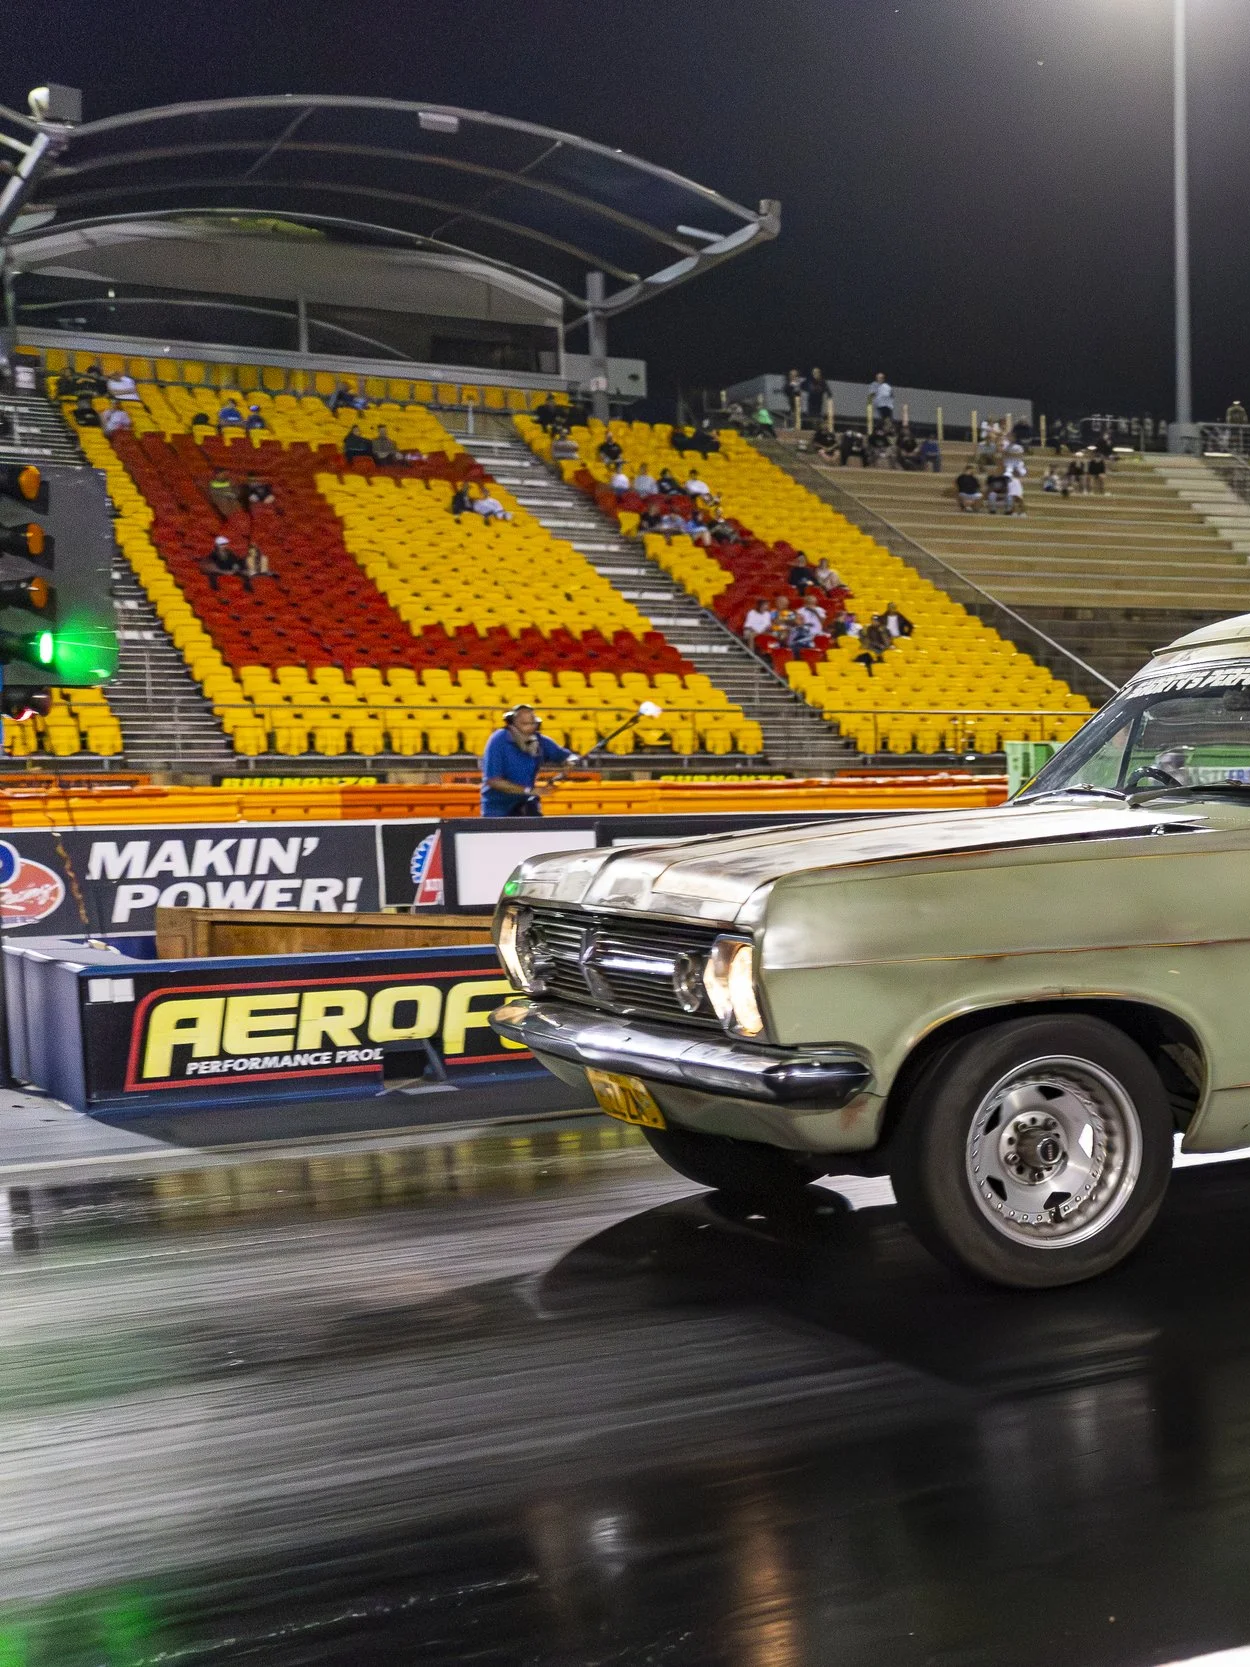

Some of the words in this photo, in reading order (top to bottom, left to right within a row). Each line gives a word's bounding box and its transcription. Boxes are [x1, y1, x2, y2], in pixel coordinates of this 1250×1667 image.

[86, 837, 320, 880] MAKIN'
[111, 876, 363, 923] POWER!
[185, 1051, 333, 1075] PERFORMANCE
